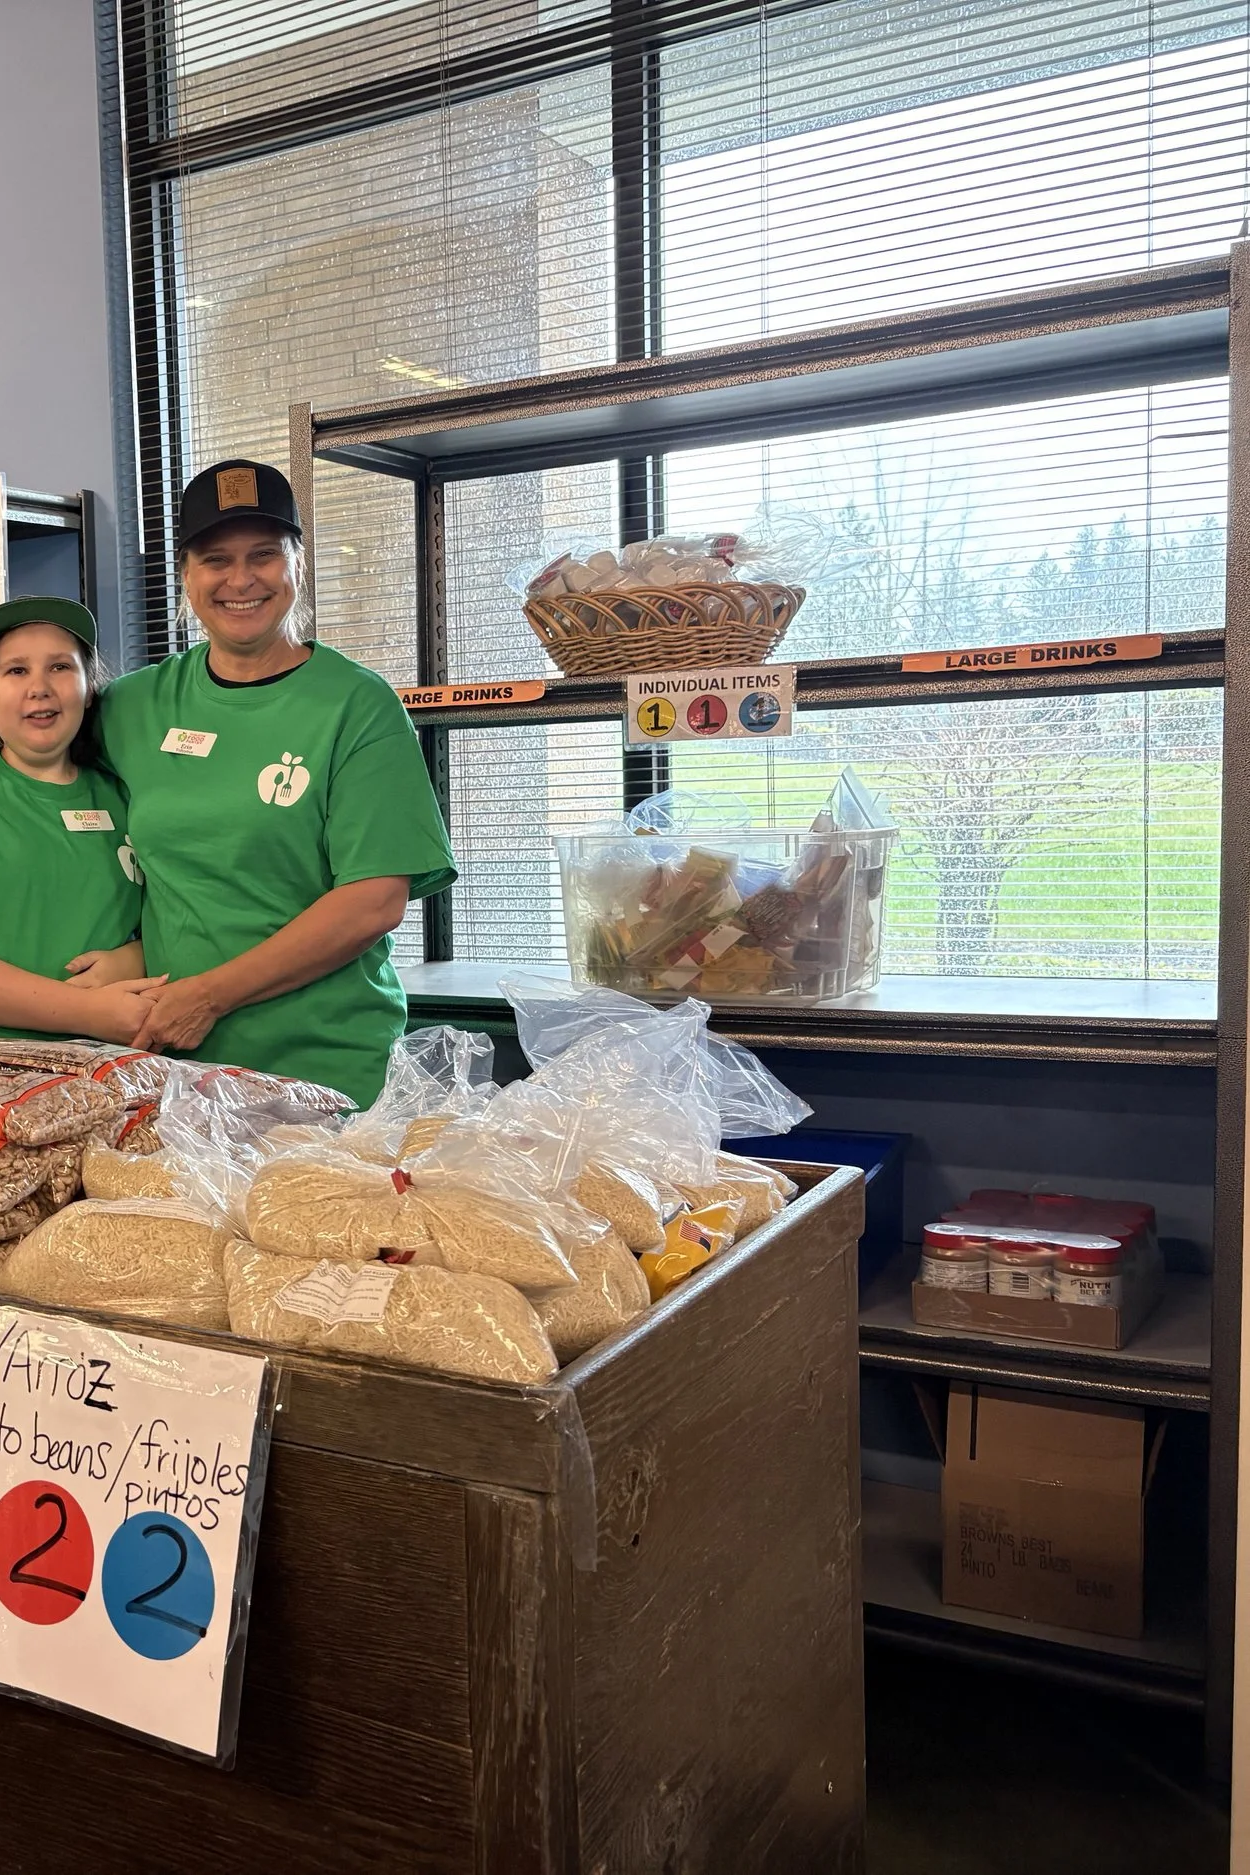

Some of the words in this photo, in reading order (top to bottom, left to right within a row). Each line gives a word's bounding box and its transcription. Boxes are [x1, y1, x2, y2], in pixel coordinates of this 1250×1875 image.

[946, 651, 1017, 668] LARGE
[1030, 643, 1117, 663] DRINKS
[402, 692, 443, 704] ARGE
[452, 687, 513, 702] DRINKS
[638, 676, 728, 696] INDIVIDUAL
[732, 674, 781, 690] ITEMS
[646, 703, 668, 731] 1
[697, 701, 720, 729] 1
[124, 1482, 220, 1530] pintos
[960, 1526, 1015, 1548] BROWNS
[1021, 1539, 1053, 1554] BEST
[10, 1493, 87, 1602] 2
[125, 1523, 207, 1638] 2
[961, 1558, 996, 1579] PINTO
